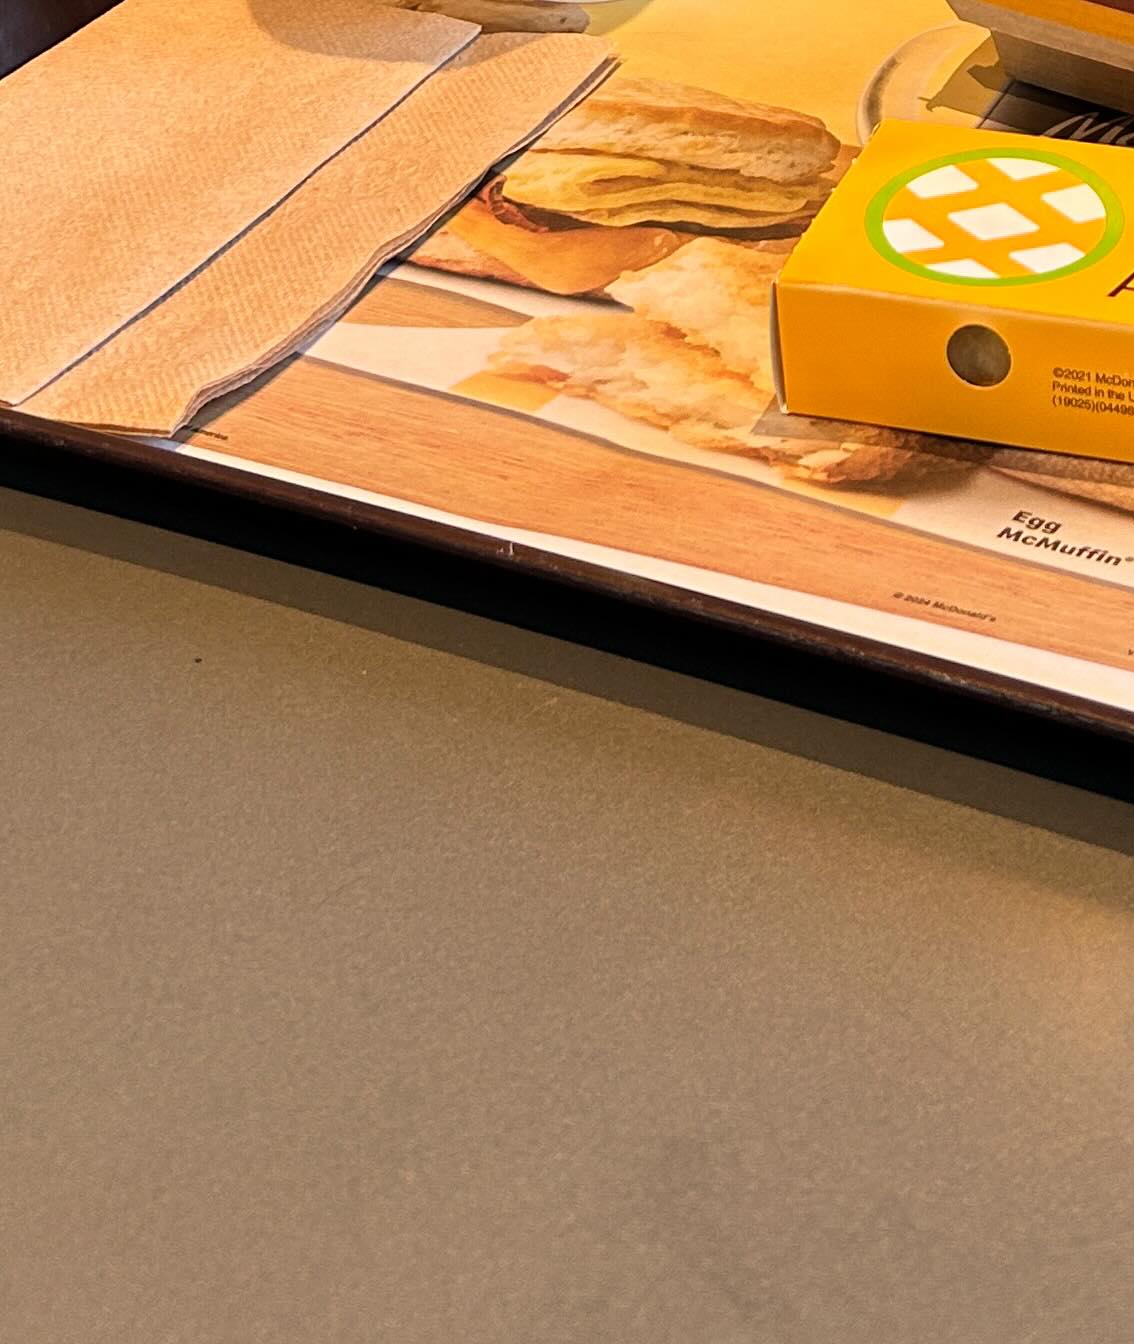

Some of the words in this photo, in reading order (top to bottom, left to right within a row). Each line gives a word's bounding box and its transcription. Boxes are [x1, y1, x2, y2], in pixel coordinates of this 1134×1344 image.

[1053, 367, 1092, 383] ©2021
[1052, 380, 1092, 396] Printed
[1094, 386, 1105, 398] in
[1107, 389, 1126, 401] the
[1011, 509, 1062, 535] Egg
[932, 600, 997, 623] McDonald's
